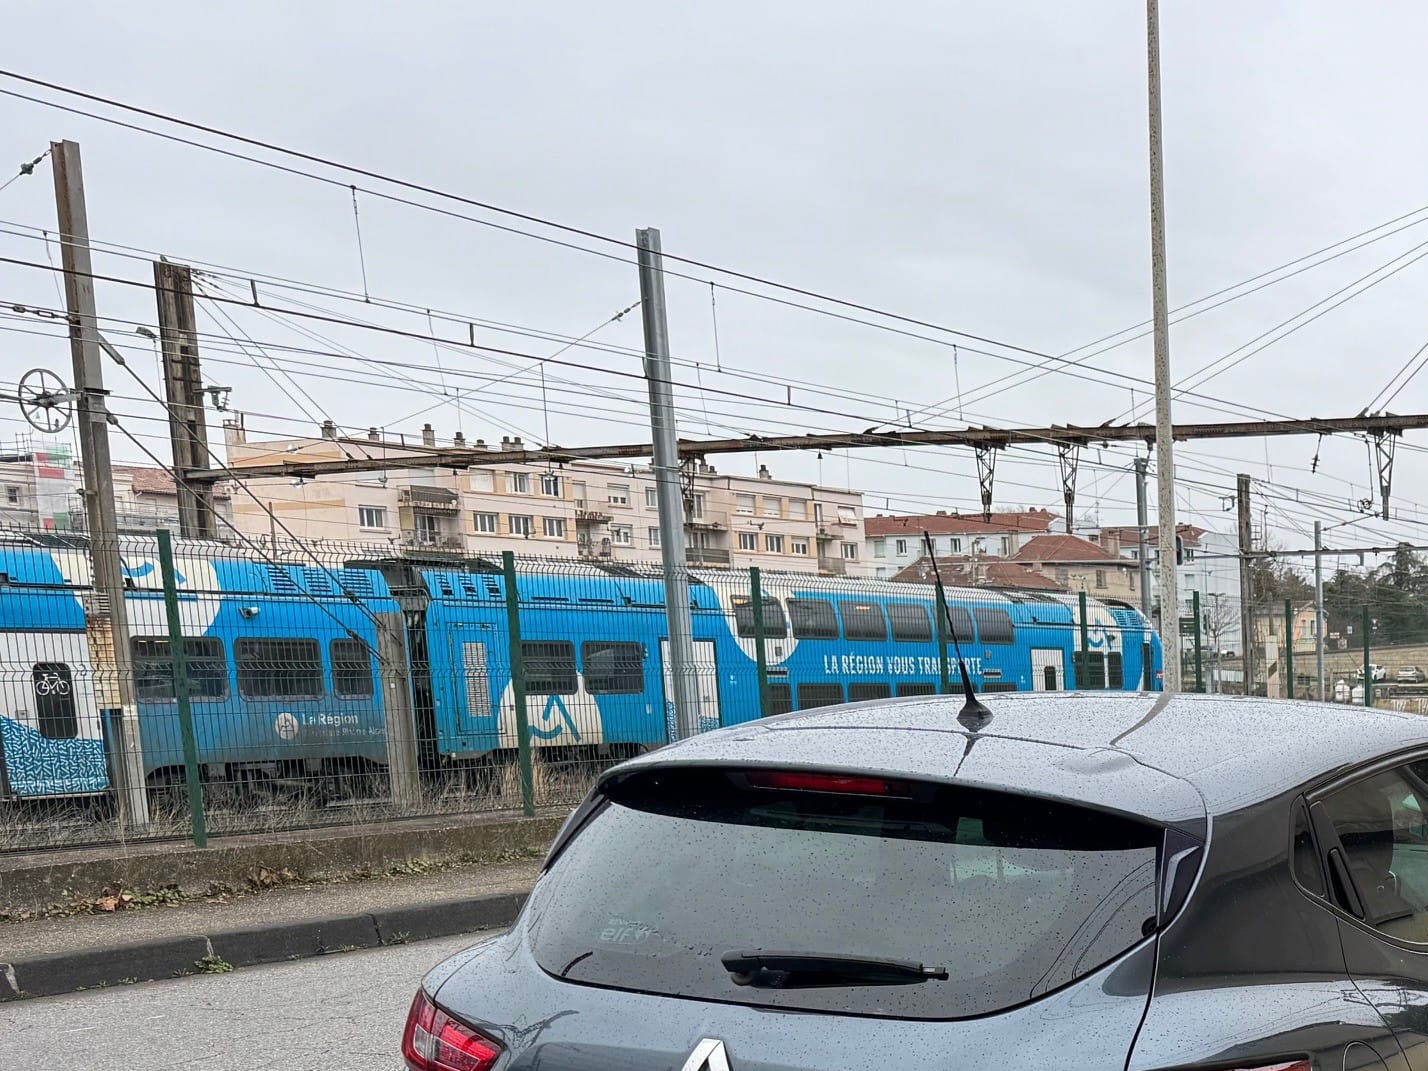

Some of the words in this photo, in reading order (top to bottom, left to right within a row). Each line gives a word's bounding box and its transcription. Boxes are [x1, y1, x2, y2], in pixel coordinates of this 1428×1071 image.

[823, 655, 839, 675] LA
[841, 652, 884, 675] RÉGION
[886, 656, 915, 675] VOUS
[301, 713, 316, 726] La
